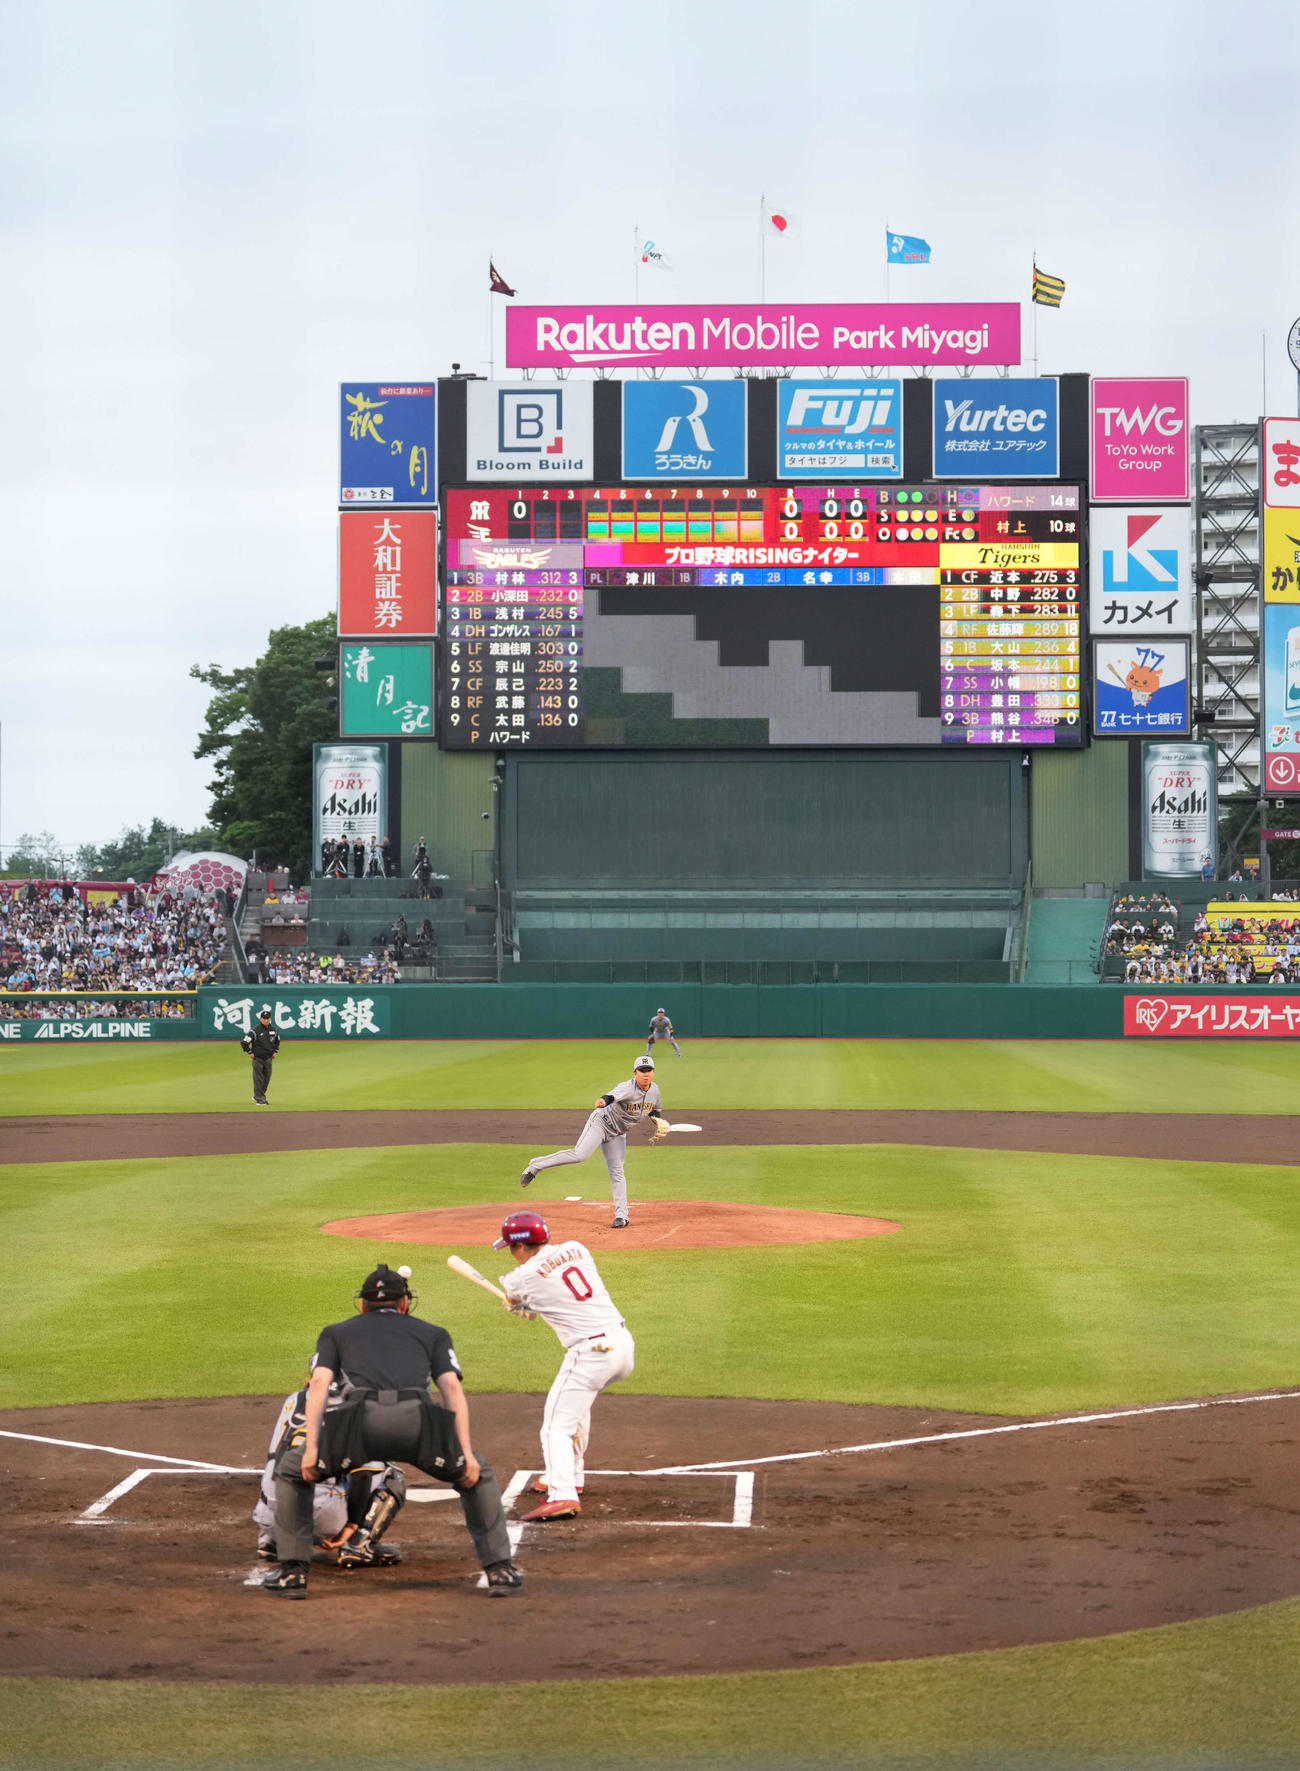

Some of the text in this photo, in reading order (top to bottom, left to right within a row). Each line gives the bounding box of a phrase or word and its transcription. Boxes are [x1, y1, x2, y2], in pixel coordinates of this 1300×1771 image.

[536, 316, 989, 354] Rakuten Mobile Park Miyagi
[786, 388, 894, 434] Fuji
[944, 400, 1047, 432] Yurtec
[1096, 403, 1183, 436] TWG
[945, 440, 1047, 452] 株式会社 ユアテック
[1140, 444, 1175, 455] Work
[477, 459, 583, 471] Bloom Build
[655, 455, 711, 470] ろうきん
[789, 456, 891, 465] タイヤはフジ 検索
[1118, 458, 1162, 472] Group
[542, 489, 757, 499] 2 3 4 5 6 7 8 9 10
[880, 491, 888, 502] B
[988, 496, 1035, 506] ハワード
[513, 500, 863, 518] 0 0 0 0
[880, 510, 888, 521] S
[785, 522, 863, 540] 0 0 0
[946, 528, 959, 540] Fc
[997, 521, 1026, 534] 村上
[666, 546, 859, 565] プロ野球RISINGナイター
[978, 547, 1040, 568] Tigers
[373, 518, 403, 629] 大和証券
[467, 572, 577, 585] 3B 村林 .312 3
[591, 572, 870, 585] PL 津川 木内 2B 名幸 3B
[961, 571, 1075, 583] CF 近本 .275 3
[451, 590, 577, 602] 2 2B 小深田 .232 0
[945, 588, 1076, 601] 2 2B 中野 .282 0
[451, 607, 577, 620] 3 1B 浅村 .245 5
[945, 606, 953, 618] 3
[1103, 599, 1179, 624] カメイ
[451, 625, 560, 637] 4 DH ゴンザレス .167
[1065, 623, 1078, 635] 18
[451, 643, 578, 655] 5 LF .303 0
[945, 641, 1076, 654] 5 大山 4
[945, 659, 1020, 671] 6 坂本
[1136, 647, 1165, 672] 77
[451, 660, 577, 673] 6 SS 宗山 .250 2
[344, 646, 430, 733] 清月記
[451, 678, 459, 690] 7
[467, 678, 483, 691] CF
[536, 678, 563, 690] .223
[569, 678, 577, 690] 2
[945, 677, 954, 689] 7
[1066, 677, 1076, 689] 0
[451, 696, 578, 709] 8 RF 武藤 .143 0
[945, 695, 1076, 707] 8 DH 豊田 0
[451, 714, 578, 727] 9 C 太田 .136 0
[945, 712, 1076, 725] 9 3B 熊谷 0
[1101, 711, 1182, 725] 77 七十七銀行
[471, 731, 530, 743] P ハワード
[991, 730, 1021, 743] 村上
[322, 792, 377, 816] Asahi
[1151, 790, 1206, 814] Asahi
[343, 821, 356, 831] 生
[1173, 819, 1186, 829] 生
[213, 997, 380, 1035] 河北新報
[1170, 1005, 1300, 1030] アイリスオーヤ
[562, 1266, 592, 1301] 0
